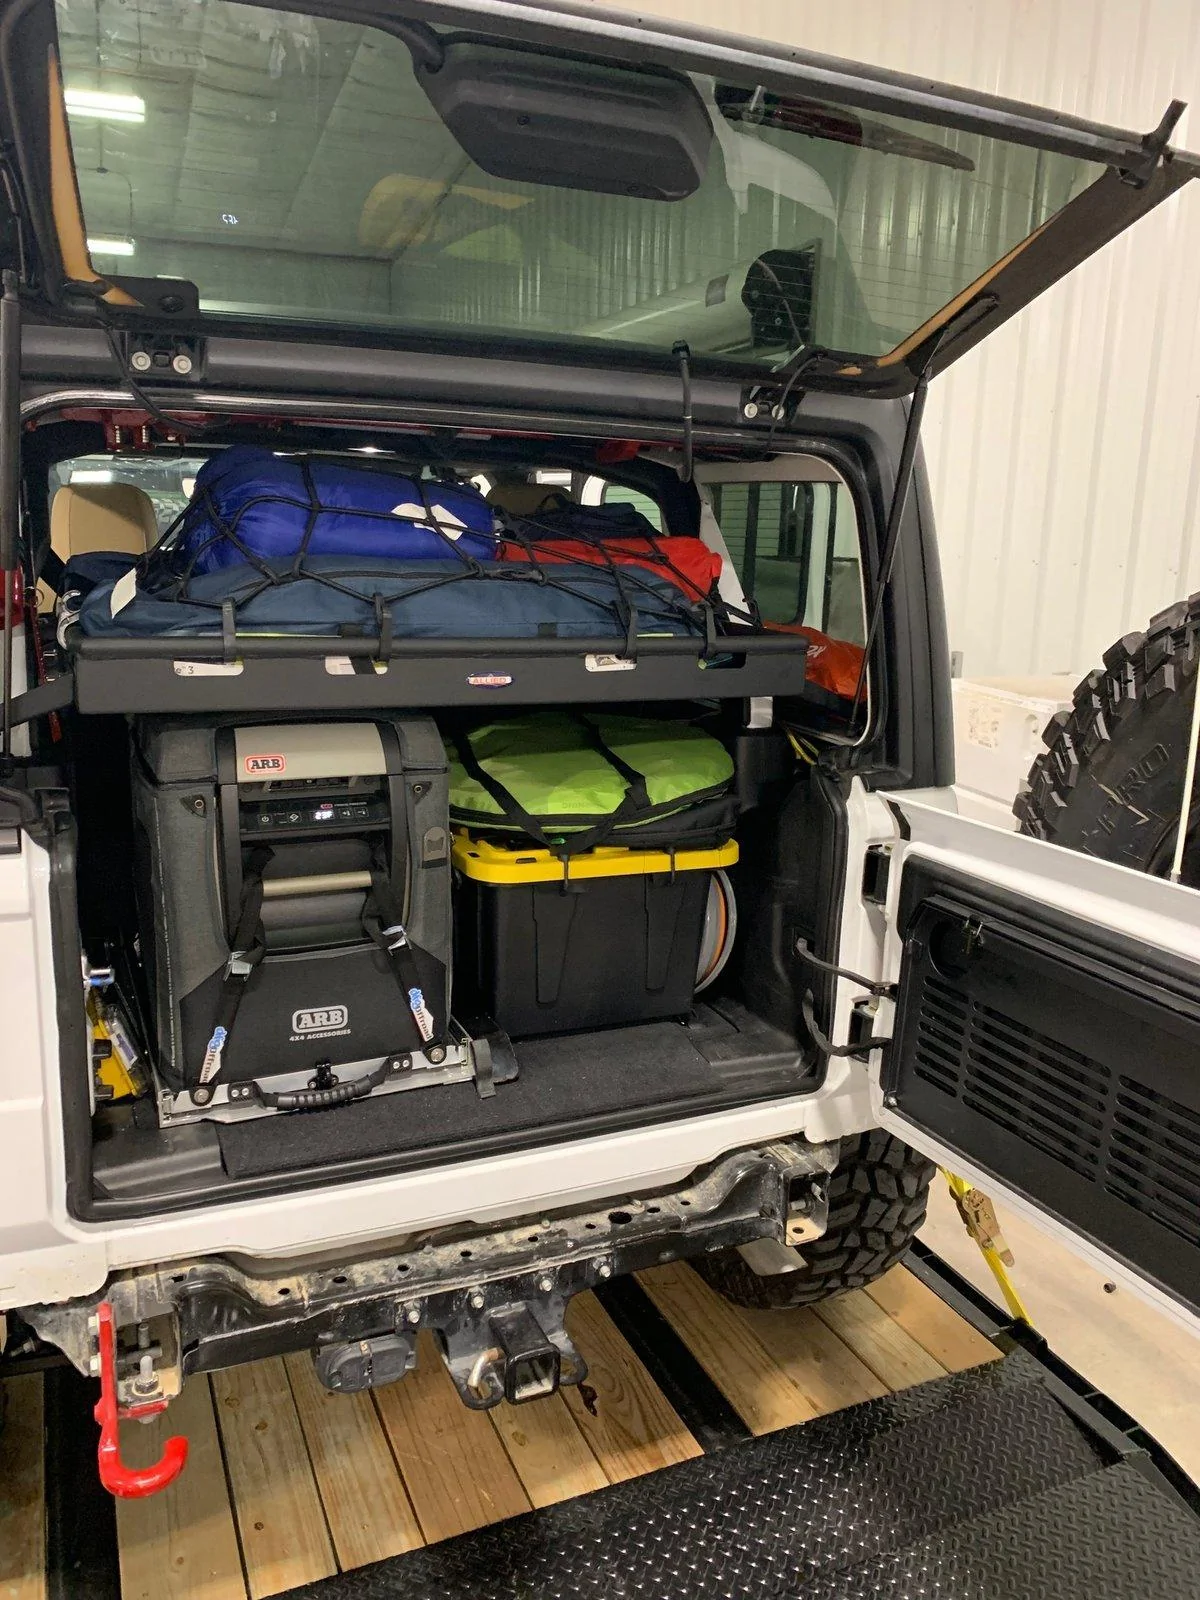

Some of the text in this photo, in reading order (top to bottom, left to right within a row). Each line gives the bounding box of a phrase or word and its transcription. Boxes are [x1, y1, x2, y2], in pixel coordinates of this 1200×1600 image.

[250, 758, 281, 770] ARB
[298, 1010, 343, 1029] ARB
[306, 1029, 352, 1040] ACCESSORIES
